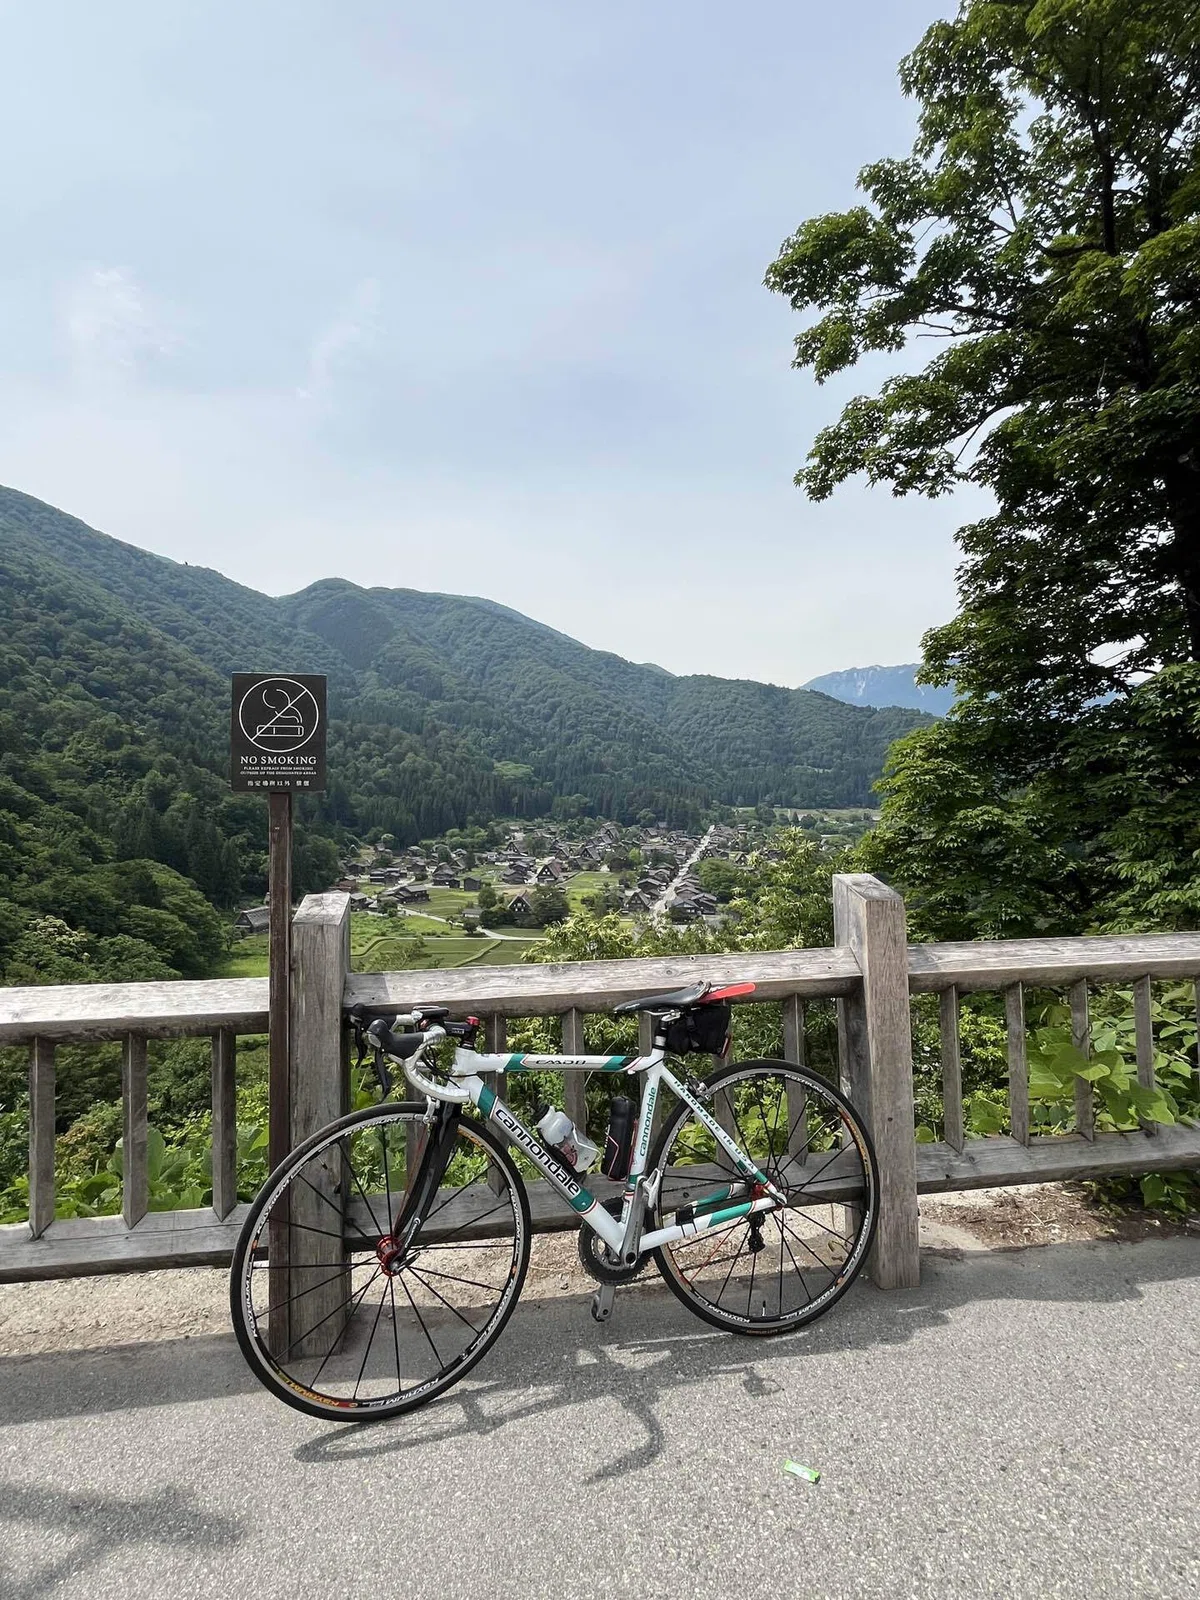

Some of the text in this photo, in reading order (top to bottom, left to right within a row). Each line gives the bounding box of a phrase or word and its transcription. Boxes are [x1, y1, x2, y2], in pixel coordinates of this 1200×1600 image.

[240, 756, 317, 765] NO SMOKING
[639, 1087, 657, 1157] cannondale
[673, 1080, 721, 1132] HANDMADE
[723, 1135, 733, 1146] IN
[494, 1108, 580, 1196] cannondale
